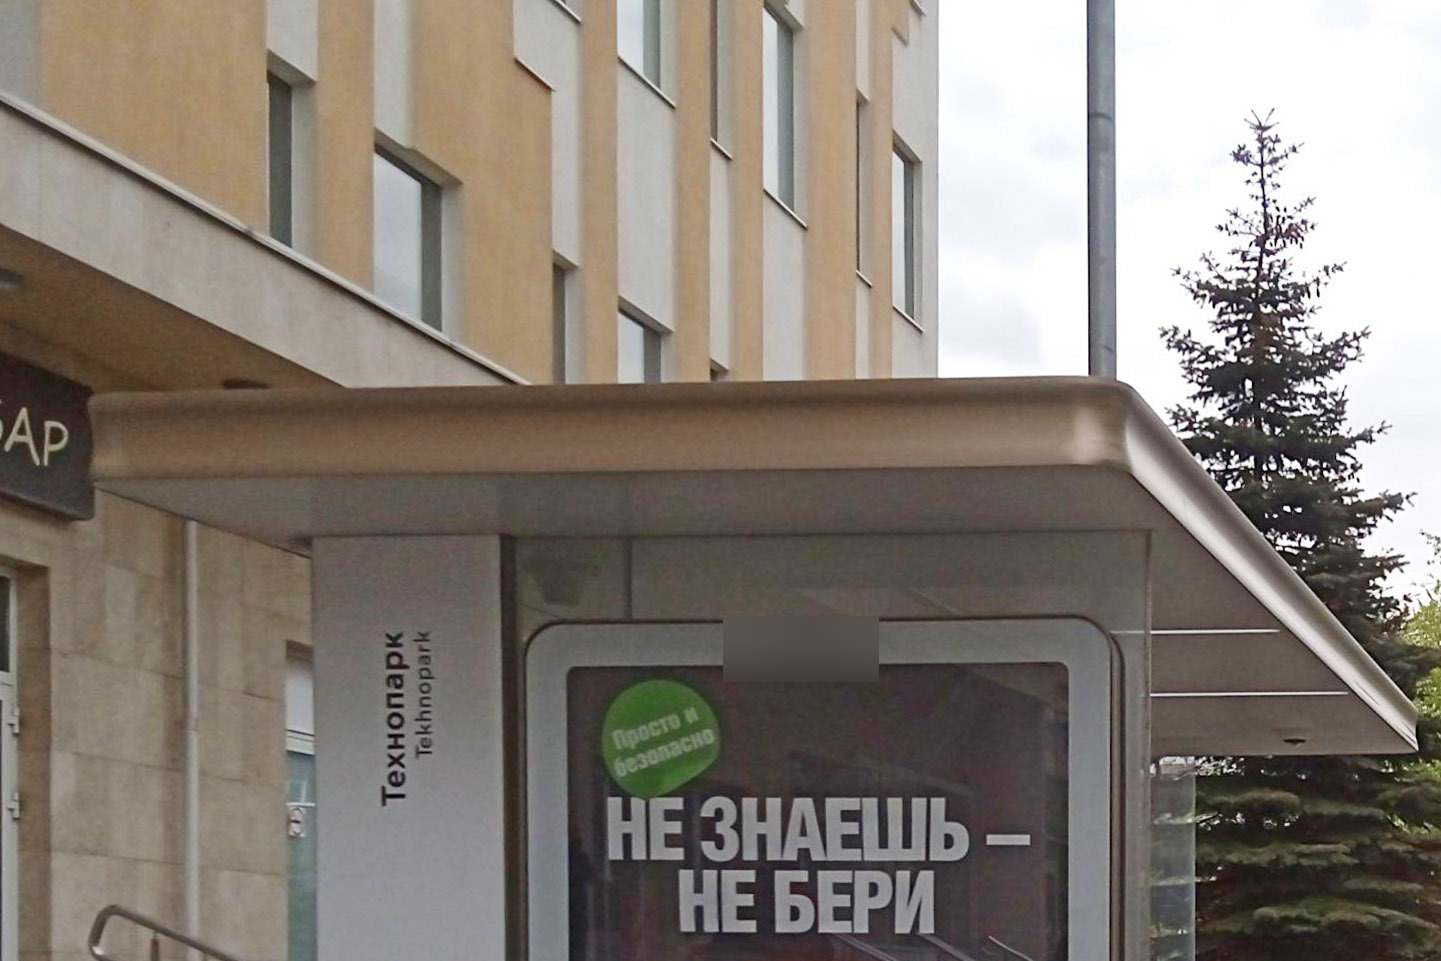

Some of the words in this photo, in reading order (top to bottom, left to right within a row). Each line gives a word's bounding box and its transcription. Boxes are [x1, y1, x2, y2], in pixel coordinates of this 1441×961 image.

[0, 398, 69, 466] АР
[381, 631, 410, 807] Технопарк
[413, 630, 435, 760] Tekhnopark
[612, 713, 681, 750] Просто
[614, 728, 715, 777] безопасно
[607, 797, 684, 860] НЕ
[700, 796, 969, 861] ЗНАЕШЬ
[679, 869, 757, 933] НЕ
[774, 870, 935, 933] БЕРИ
